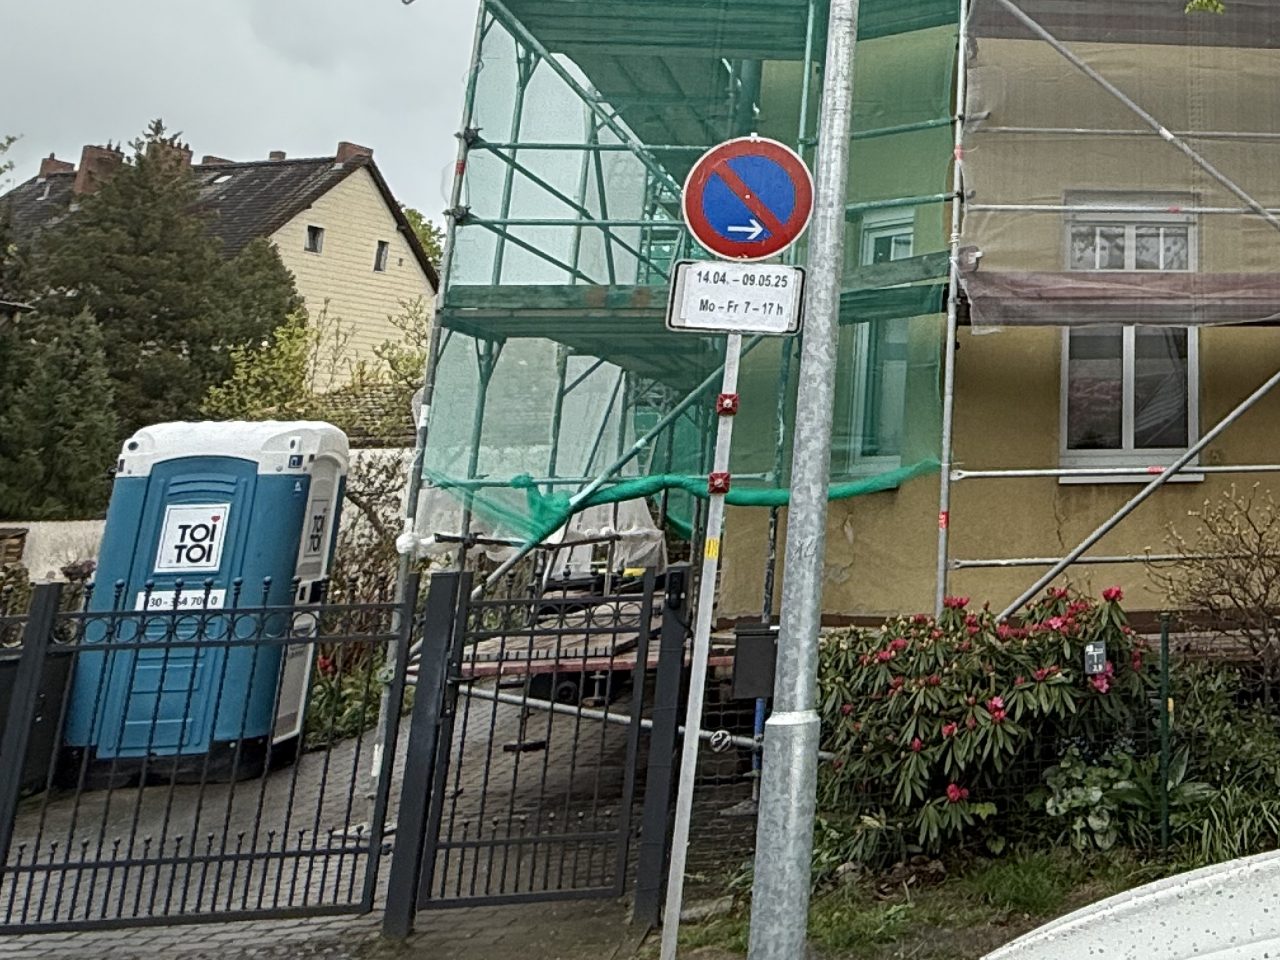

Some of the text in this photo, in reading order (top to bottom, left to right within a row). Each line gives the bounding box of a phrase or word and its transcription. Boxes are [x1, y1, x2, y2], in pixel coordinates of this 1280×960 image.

[697, 270, 730, 285] 14.04.
[742, 273, 788, 288] 09.05.25
[699, 298, 715, 312] Mo
[727, 300, 739, 313] Fr
[744, 301, 751, 313] 7
[762, 302, 774, 315] 17
[776, 303, 783, 315] h
[178, 523, 217, 543] TOI
[174, 543, 213, 564] TOI
